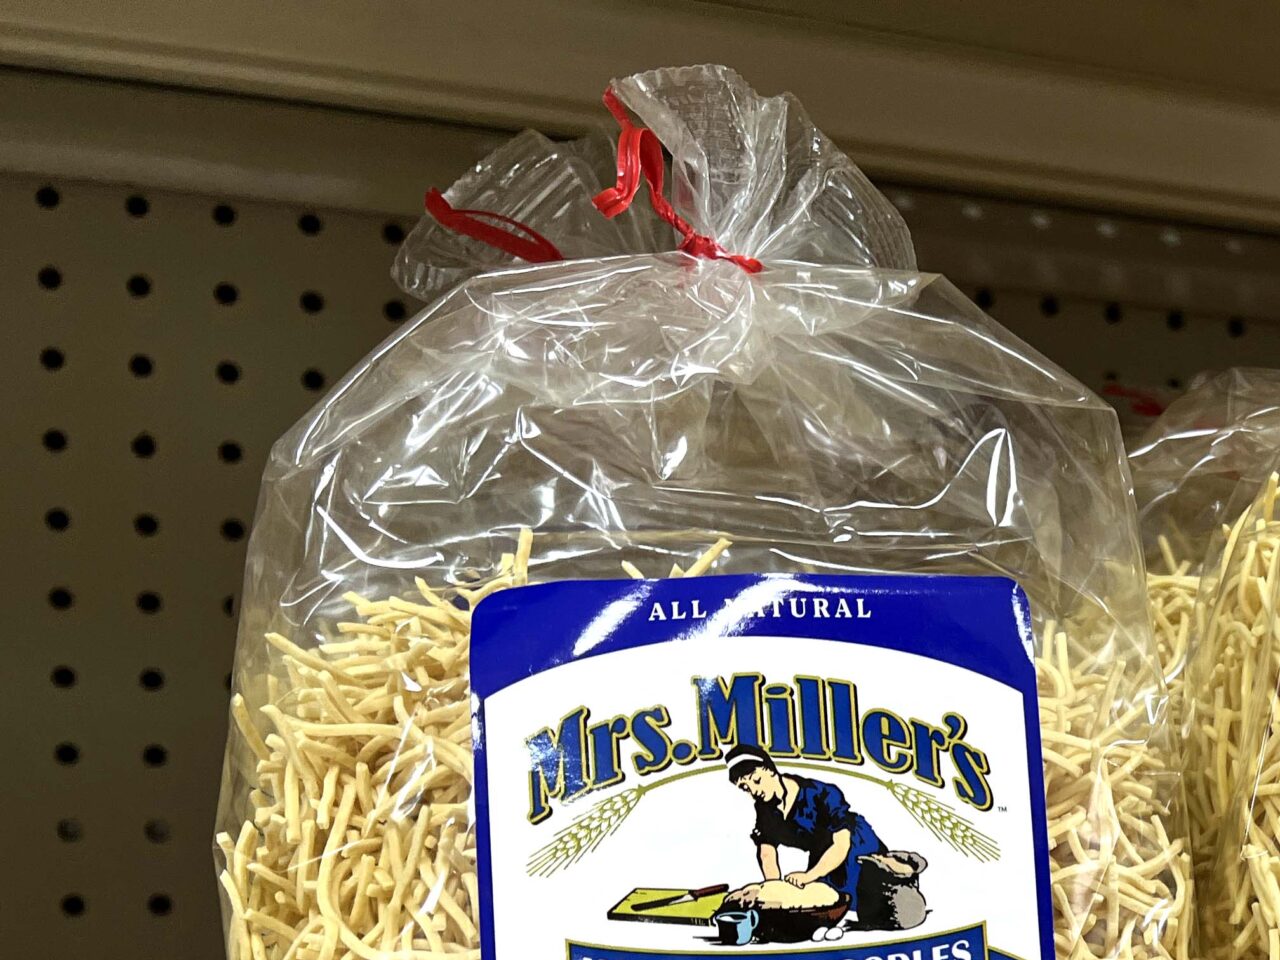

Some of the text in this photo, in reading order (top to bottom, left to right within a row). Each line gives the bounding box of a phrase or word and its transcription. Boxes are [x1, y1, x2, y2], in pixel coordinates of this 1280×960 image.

[648, 597, 872, 621] ALL TURAL
[524, 671, 995, 826] Mrs. Miller's
